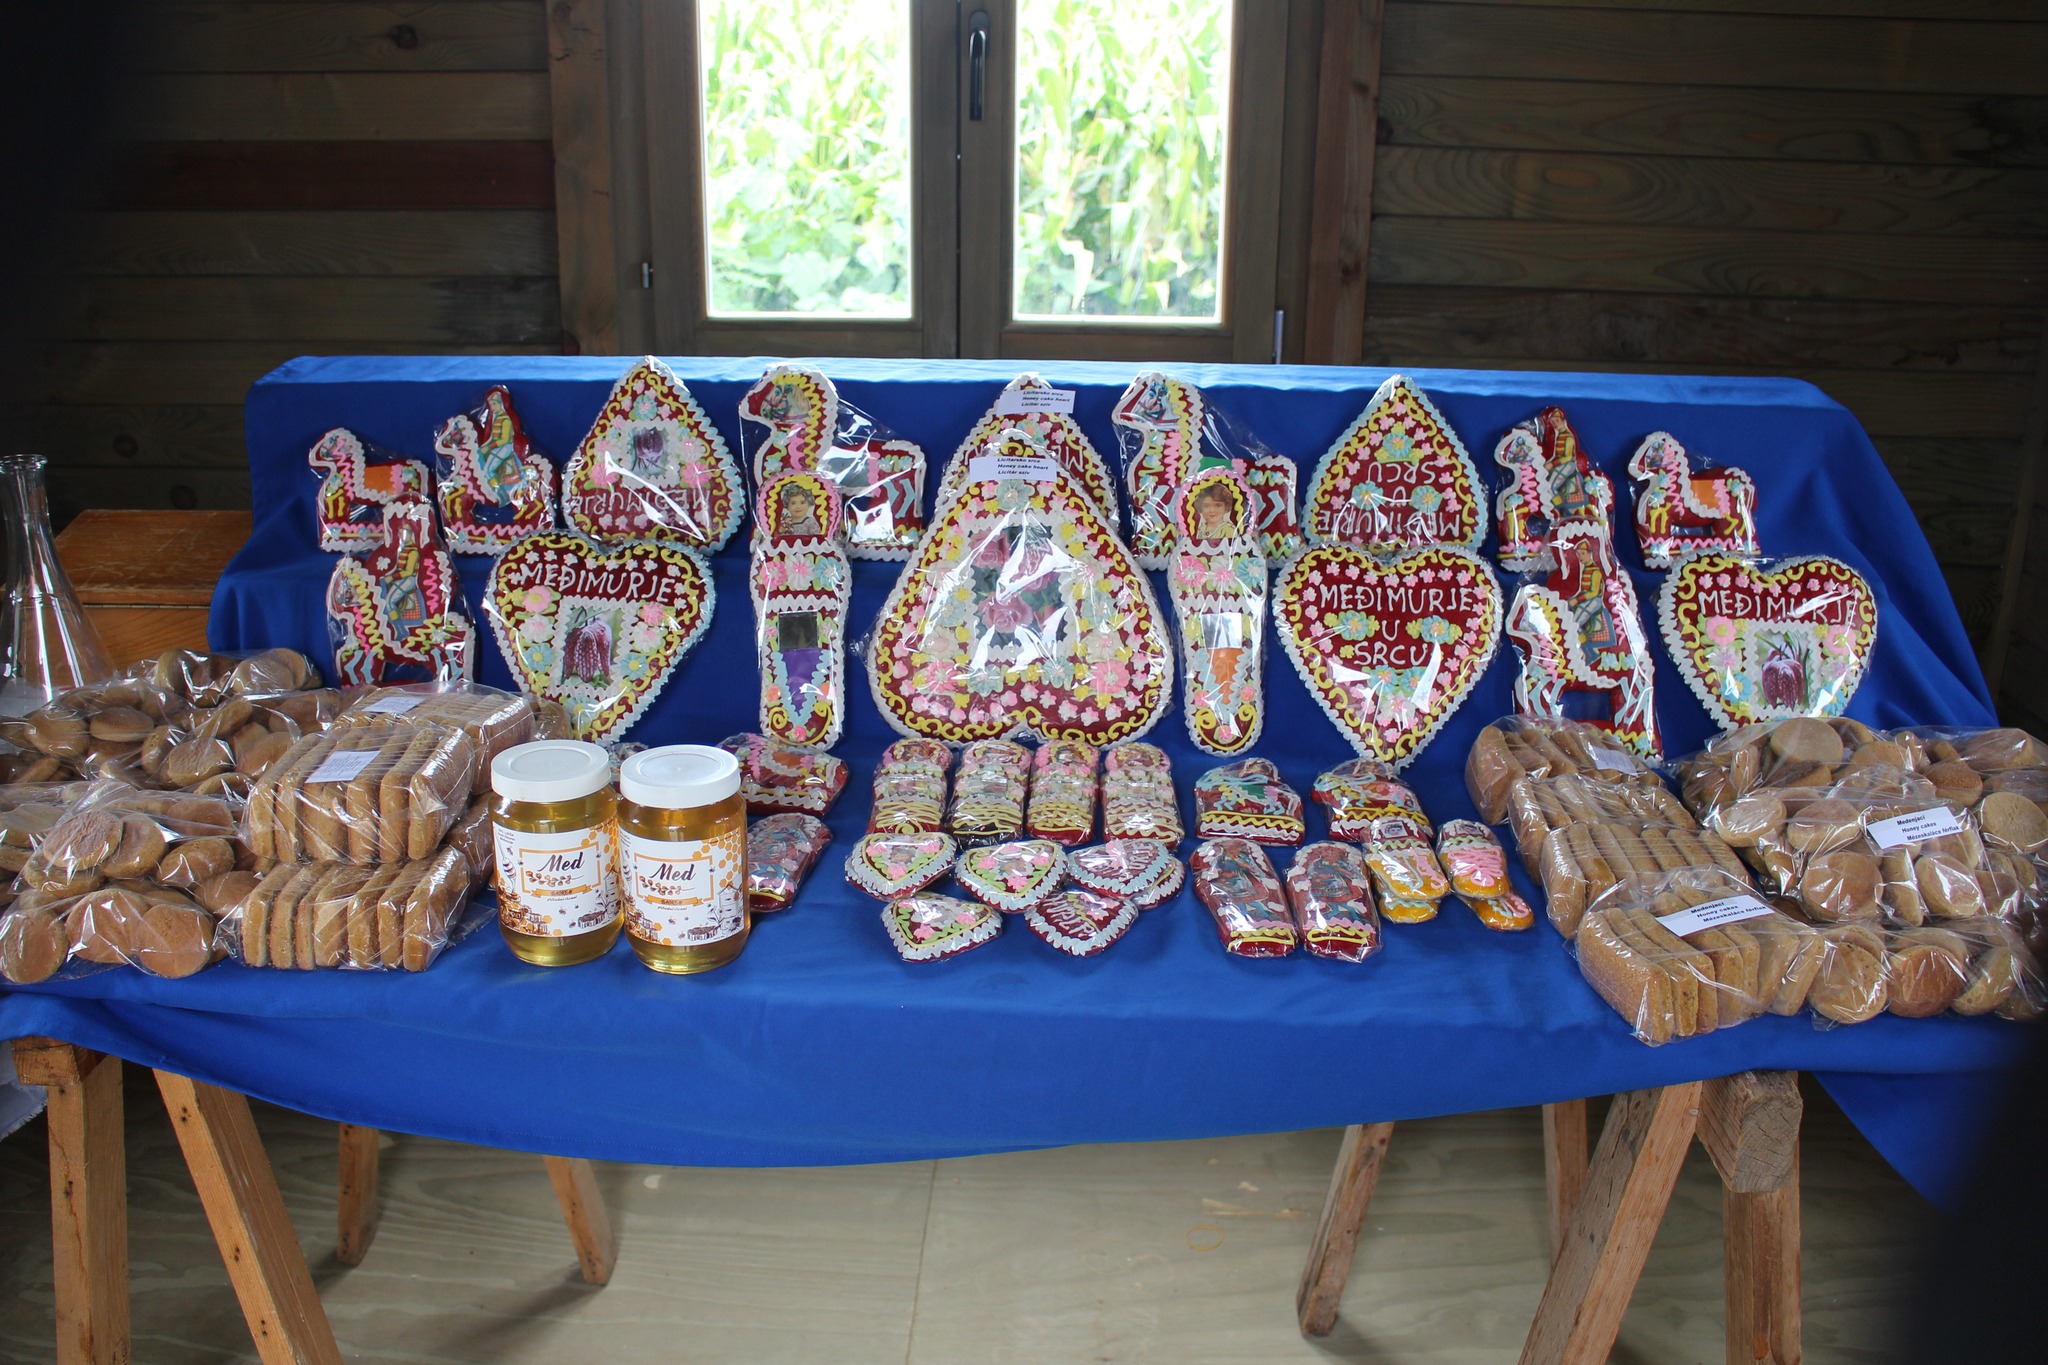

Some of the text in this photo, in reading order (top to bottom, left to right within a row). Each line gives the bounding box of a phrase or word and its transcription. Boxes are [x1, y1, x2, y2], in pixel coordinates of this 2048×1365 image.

[1367, 461, 1436, 484] SRCU
[520, 562, 676, 603] MEĐIMURJE
[1320, 583, 1474, 614] MEĐIMURJE
[1381, 619, 1400, 642] U
[1354, 641, 1429, 666] SRCU
[1897, 815, 1925, 826] Medenjaci
[1901, 825, 1920, 833] Honey
[537, 851, 585, 873] Med
[649, 862, 697, 881] Med
[1690, 902, 1724, 914] Medenjaci
[1696, 909, 1718, 918] Honey
